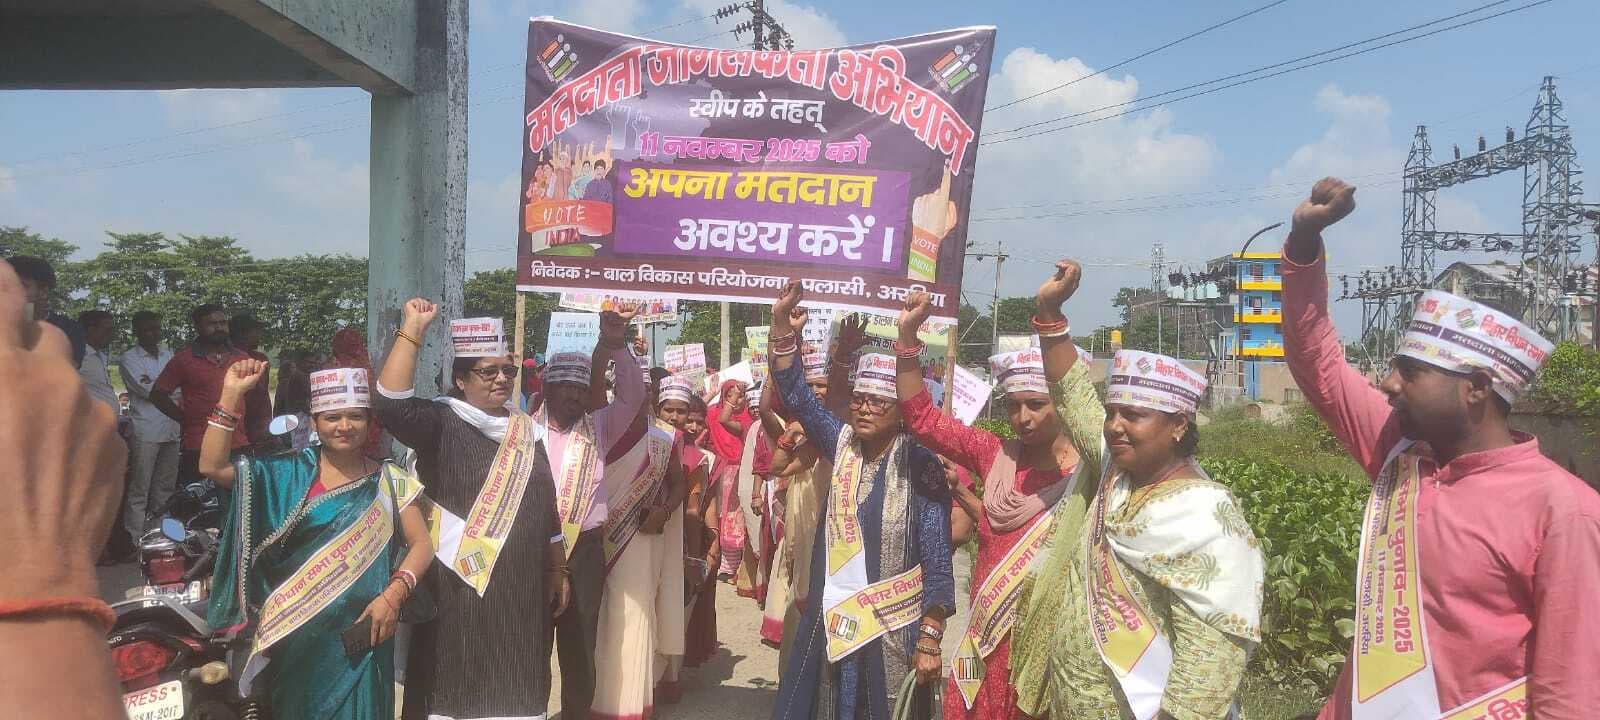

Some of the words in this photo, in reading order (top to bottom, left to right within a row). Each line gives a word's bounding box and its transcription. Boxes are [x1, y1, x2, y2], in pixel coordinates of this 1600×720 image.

[527, 46, 642, 153] मतदाता
[829, 45, 974, 176] अभियान
[689, 89, 741, 118] स्वीप
[742, 90, 768, 119] के
[770, 98, 827, 133] तहत्
[638, 131, 659, 157] 11
[663, 136, 764, 162] नवम्बर
[766, 138, 821, 162] 2025
[826, 133, 871, 164] को
[623, 167, 726, 201] अपना
[736, 170, 877, 207] मतदान
[543, 204, 586, 224] VOTE
[673, 217, 793, 255] अवश्य
[798, 214, 876, 261] करें
[913, 235, 938, 254] VOTE
[531, 261, 582, 279] निवेदक
[603, 267, 638, 282] बाल
[638, 264, 696, 286] विकास
[1480, 314, 1508, 337] बिहार
[1505, 326, 1530, 351] विधान
[465, 504, 491, 540] बिहार
[481, 470, 507, 507] विधान
[496, 449, 514, 471] सभा
[272, 575, 307, 608] विधान
[304, 556, 331, 582] सभा
[856, 584, 893, 609] बिहार
[978, 574, 1012, 611] विधान
[1007, 549, 1035, 578] सभा
[1386, 527, 1414, 653] चुनाव-2025
[1375, 615, 1386, 643] 2025
